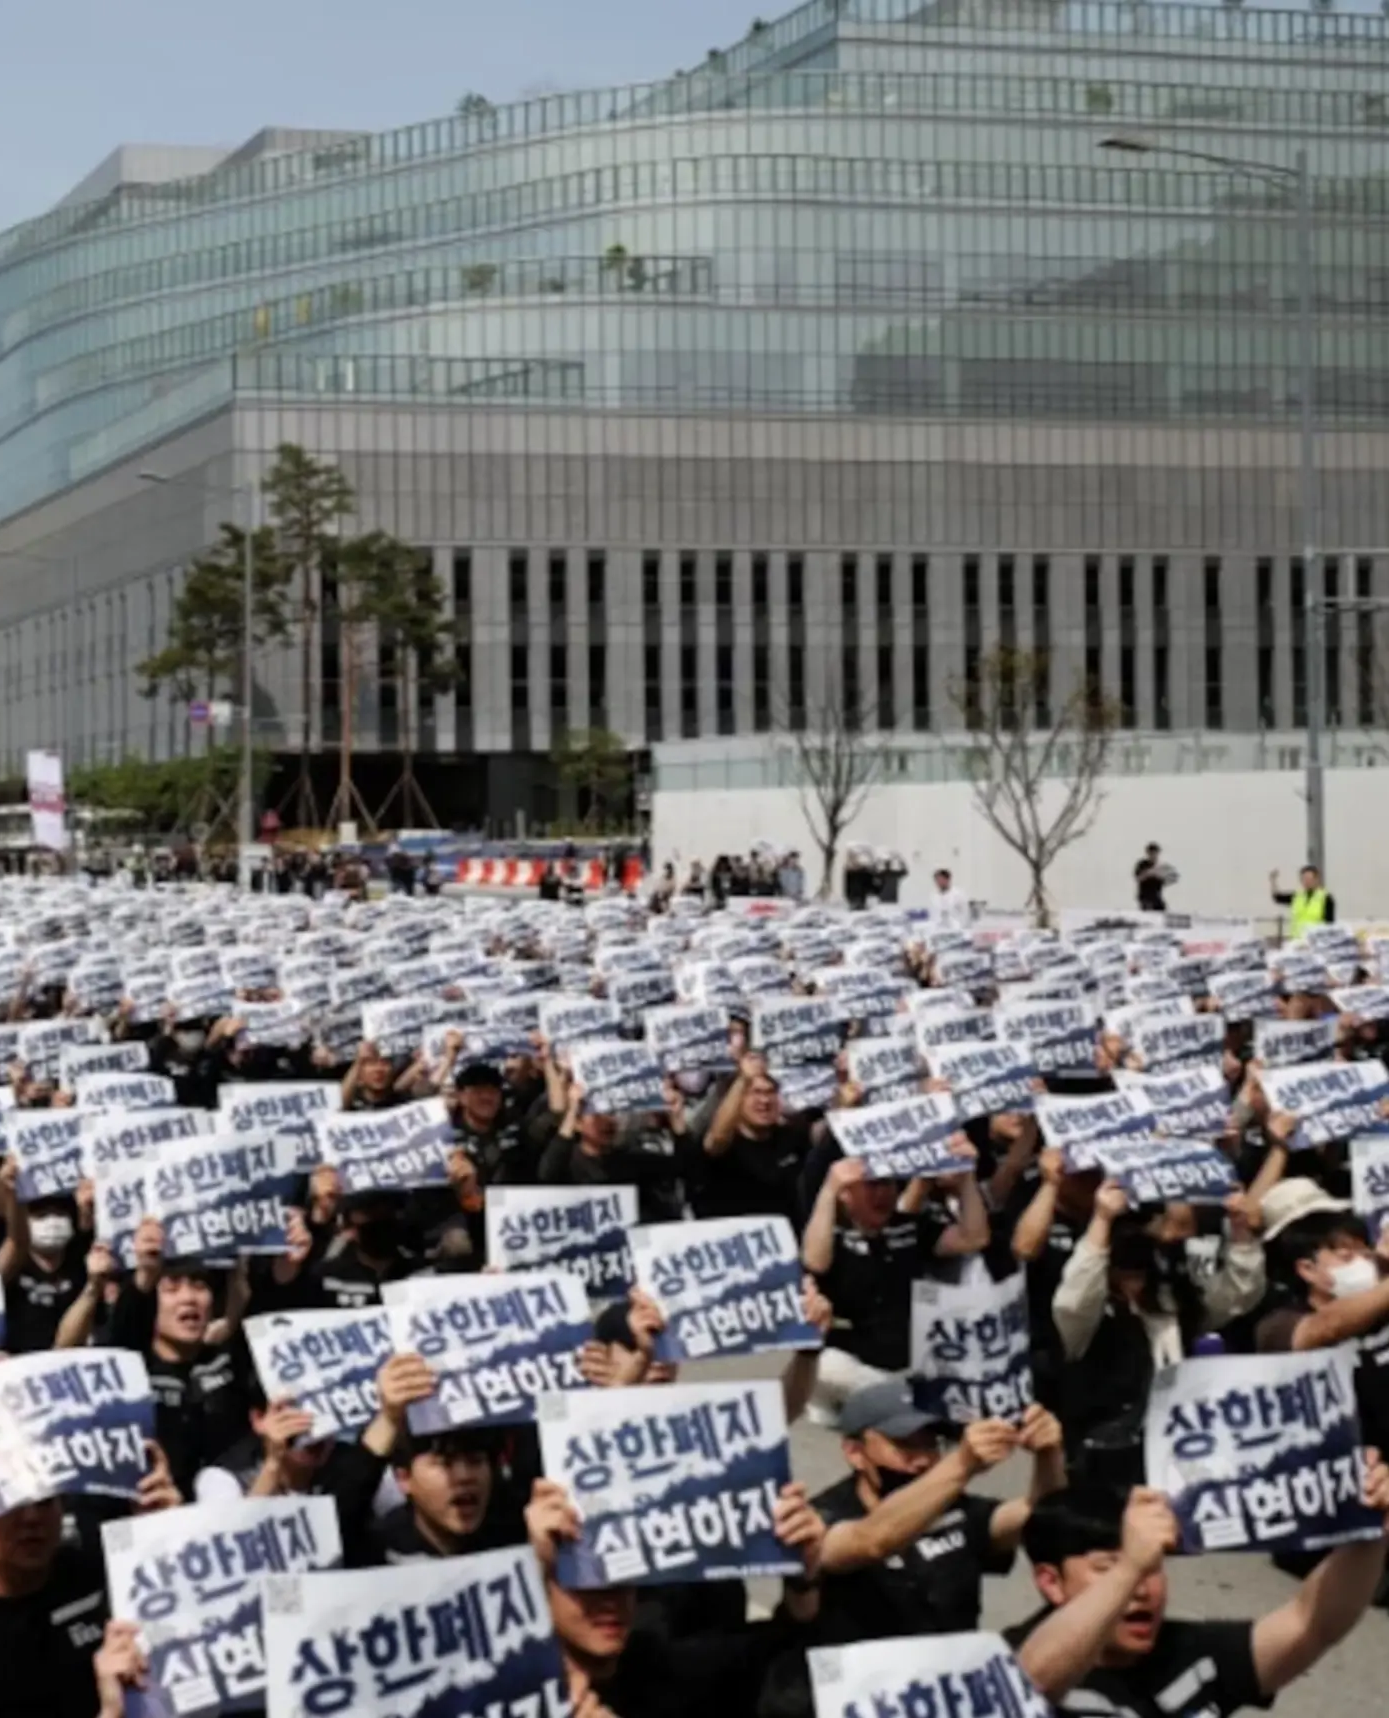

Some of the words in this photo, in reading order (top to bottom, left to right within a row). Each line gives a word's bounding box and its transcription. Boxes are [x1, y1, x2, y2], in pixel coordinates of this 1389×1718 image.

[1005, 1005, 1087, 1040] 상한폐지
[938, 1049, 1019, 1089] 상한폐지
[1277, 1067, 1365, 1108] 상한폐지
[93, 1113, 197, 1161] 상한폐지
[231, 1088, 328, 1132] 상한폐지
[327, 1105, 429, 1153] 상한폐지
[843, 1098, 939, 1149] 상한폐지
[1044, 1098, 1139, 1137] 상한폐지
[153, 1140, 276, 1200] 상한폐지
[344, 1144, 447, 1188] 실현하자
[1132, 1154, 1231, 1201] 실현하자
[169, 1197, 290, 1256] 실현하자
[499, 1193, 623, 1252] 상한폐지
[650, 1225, 779, 1297] 상한폐지
[271, 1316, 392, 1381] 상한폐지
[410, 1281, 568, 1357] 상한폐지
[677, 1284, 807, 1356] 실현하자
[439, 1352, 585, 1423] 실현하자
[1166, 1359, 1345, 1459] 상한폐지
[36, 1424, 147, 1484] 현하자
[564, 1391, 763, 1492] 상한폐지
[1194, 1449, 1367, 1551] 실현하자
[593, 1479, 779, 1582] 실현하자
[130, 1507, 318, 1620] 상한폐지
[288, 1562, 537, 1713] 상한폐지
[161, 1624, 266, 1714] 실현
